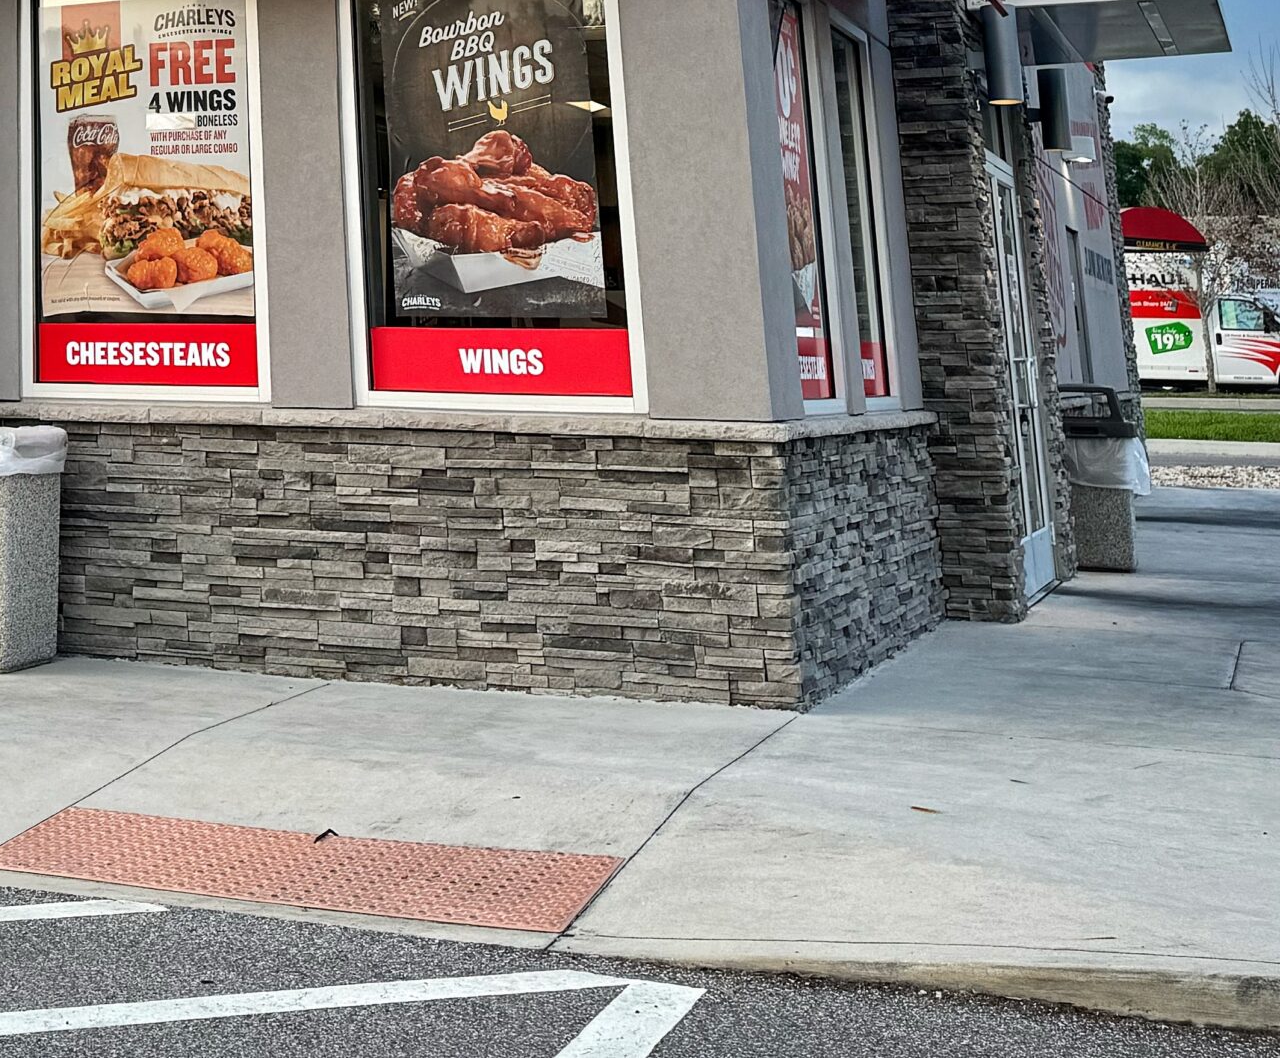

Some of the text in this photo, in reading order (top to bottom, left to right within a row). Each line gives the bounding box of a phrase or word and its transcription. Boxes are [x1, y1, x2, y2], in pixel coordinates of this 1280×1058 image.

[153, 8, 236, 32] CHARLEYS
[419, 11, 504, 47] Bourbon
[451, 31, 495, 61] BBQ
[51, 45, 142, 88] ROYAL
[149, 38, 236, 87] FREE
[431, 39, 554, 111] WINGS
[57, 73, 136, 111] MEAL
[148, 89, 236, 113] 4 WINGS
[197, 114, 238, 128] BONELESS
[150, 130, 227, 142] WITH PURCHASE OF ANY
[151, 143, 238, 155] REGULAR OR LARGE COMBO
[401, 296, 441, 308] CHARLEYS
[66, 341, 231, 367] CHEESESTEAKS
[458, 348, 544, 375] WINGS
